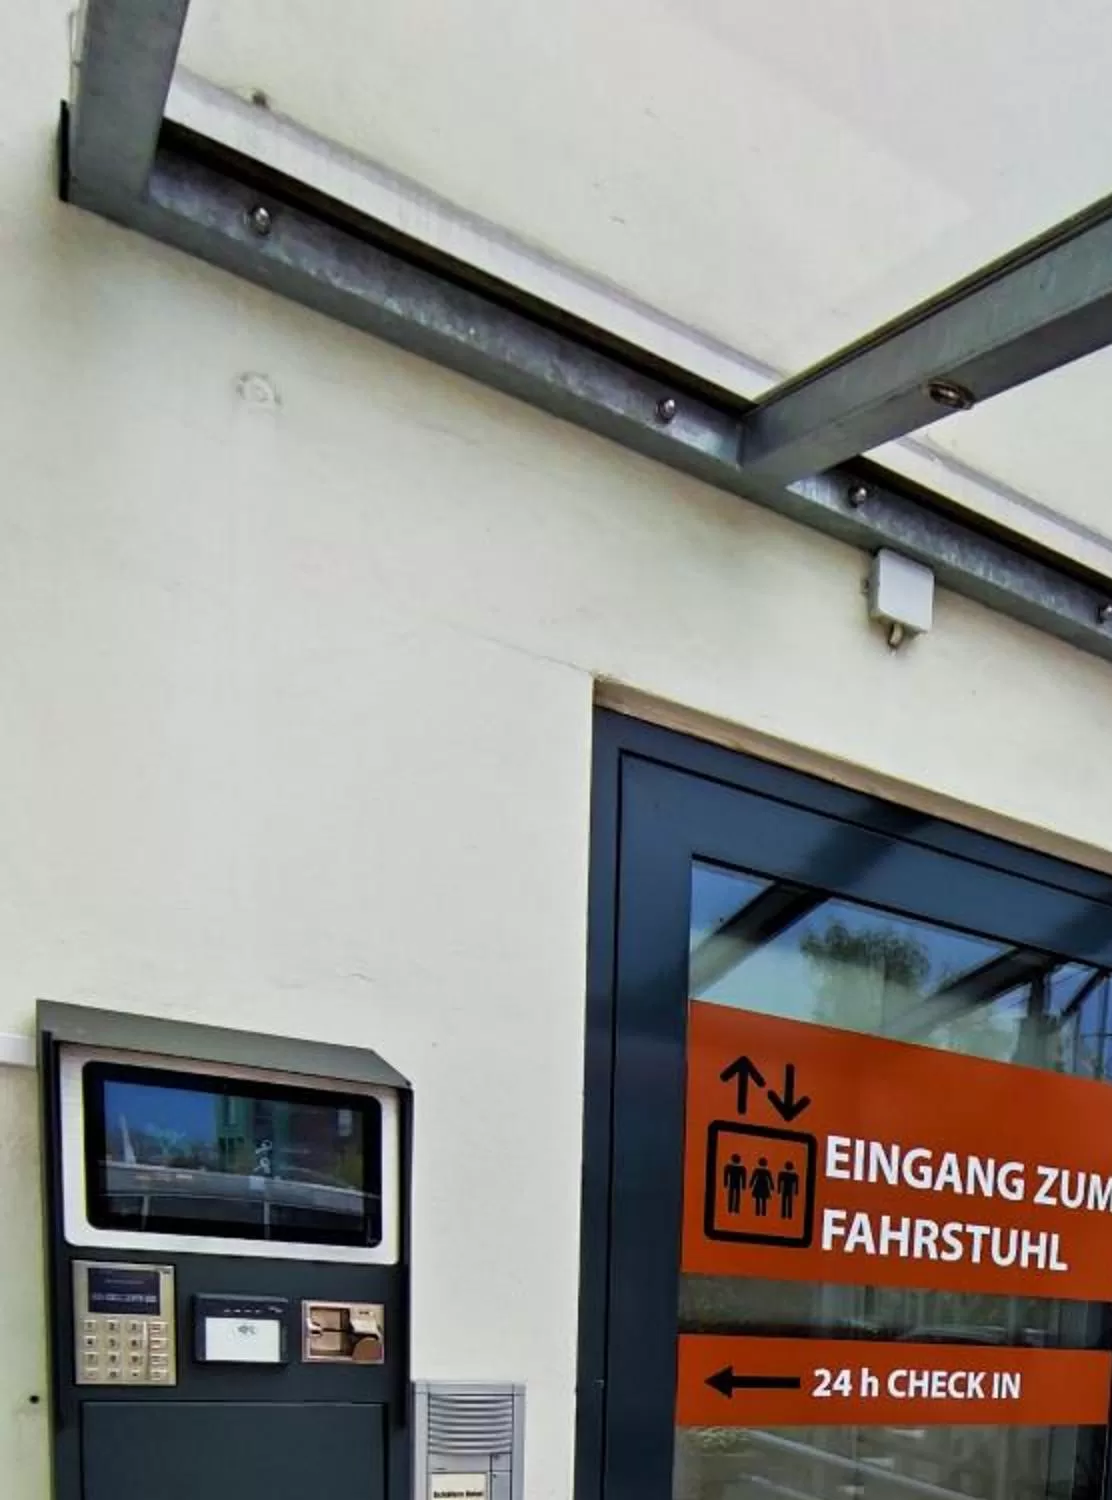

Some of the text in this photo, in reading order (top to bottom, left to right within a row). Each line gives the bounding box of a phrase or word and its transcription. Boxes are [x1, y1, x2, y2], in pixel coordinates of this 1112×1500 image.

[824, 1135, 1025, 1200] EINGANG
[821, 1208, 1068, 1271] FAHRSTUHL
[812, 1367, 1021, 1399] 24 h CHECK IN
